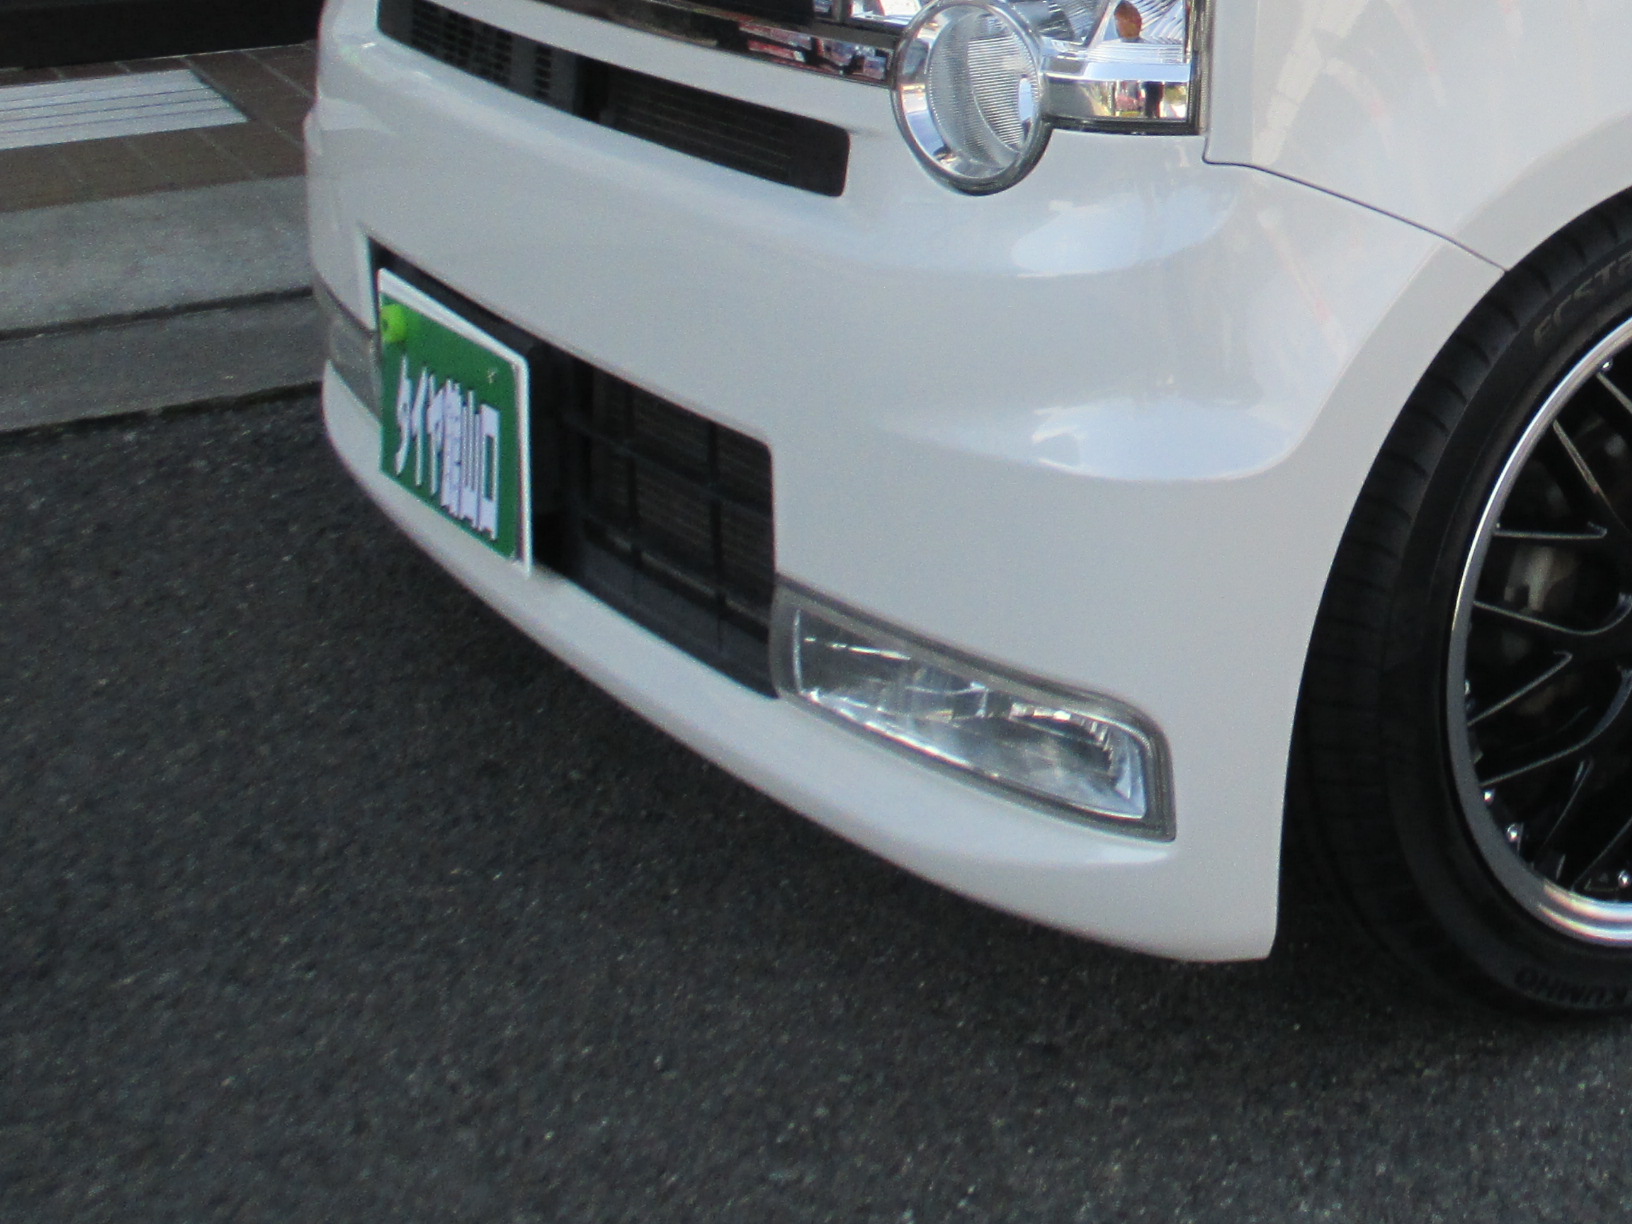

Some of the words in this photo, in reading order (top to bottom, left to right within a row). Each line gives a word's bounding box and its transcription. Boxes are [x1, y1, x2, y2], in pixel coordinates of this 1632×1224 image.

[394, 353, 500, 542] タイヤ館山口
